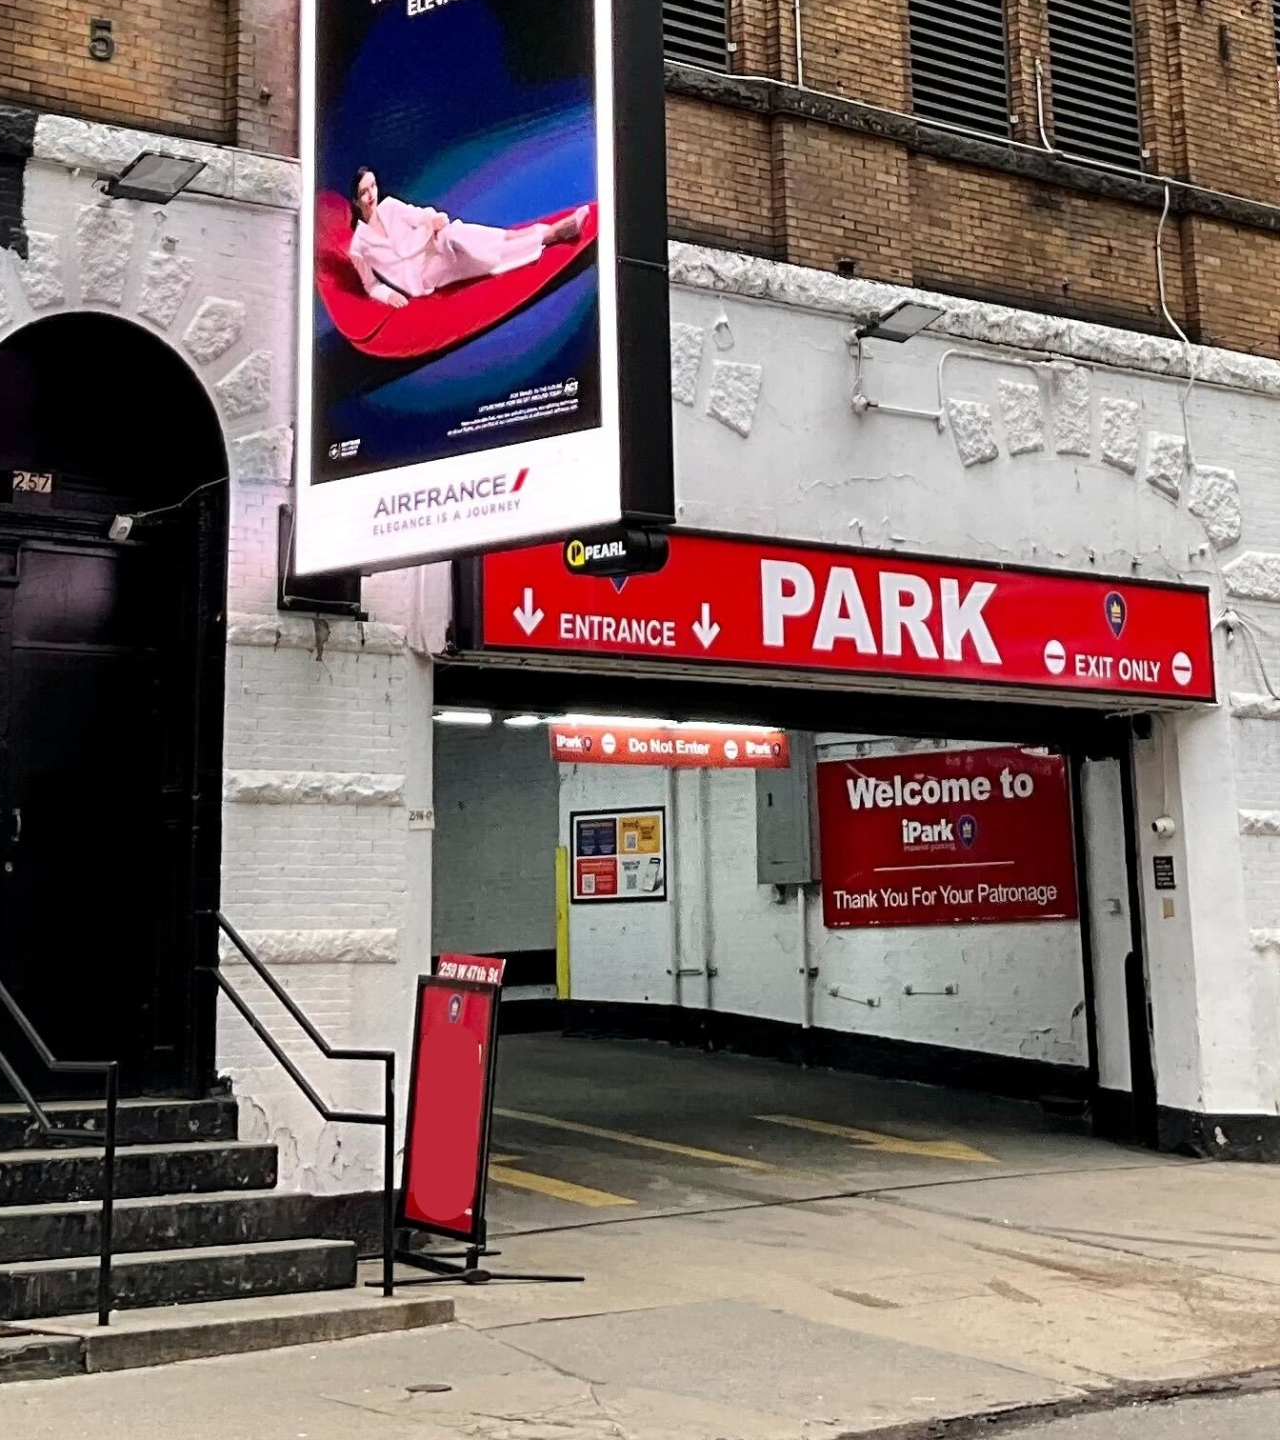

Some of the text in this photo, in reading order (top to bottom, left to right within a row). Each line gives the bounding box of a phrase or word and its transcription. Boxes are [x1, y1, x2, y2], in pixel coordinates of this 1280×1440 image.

[89, 17, 115, 61] 5
[14, 472, 50, 491] 257
[373, 474, 507, 518] AIRFRANCE
[372, 499, 521, 536] ELEGANCE IS A JOURNEY
[585, 541, 627, 560] PEARL
[761, 558, 1003, 665] PARK
[559, 613, 676, 647] ENTRANCE
[1075, 654, 1162, 685] EXIT ONLY
[628, 738, 648, 753] Do
[650, 738, 673, 754] Not
[675, 739, 710, 755] Enter
[846, 767, 1034, 810] Welcome to
[902, 819, 954, 843] iPark
[833, 883, 1058, 910] Thank You For Your Patronage
[439, 961, 499, 983] 259 W 47th St
